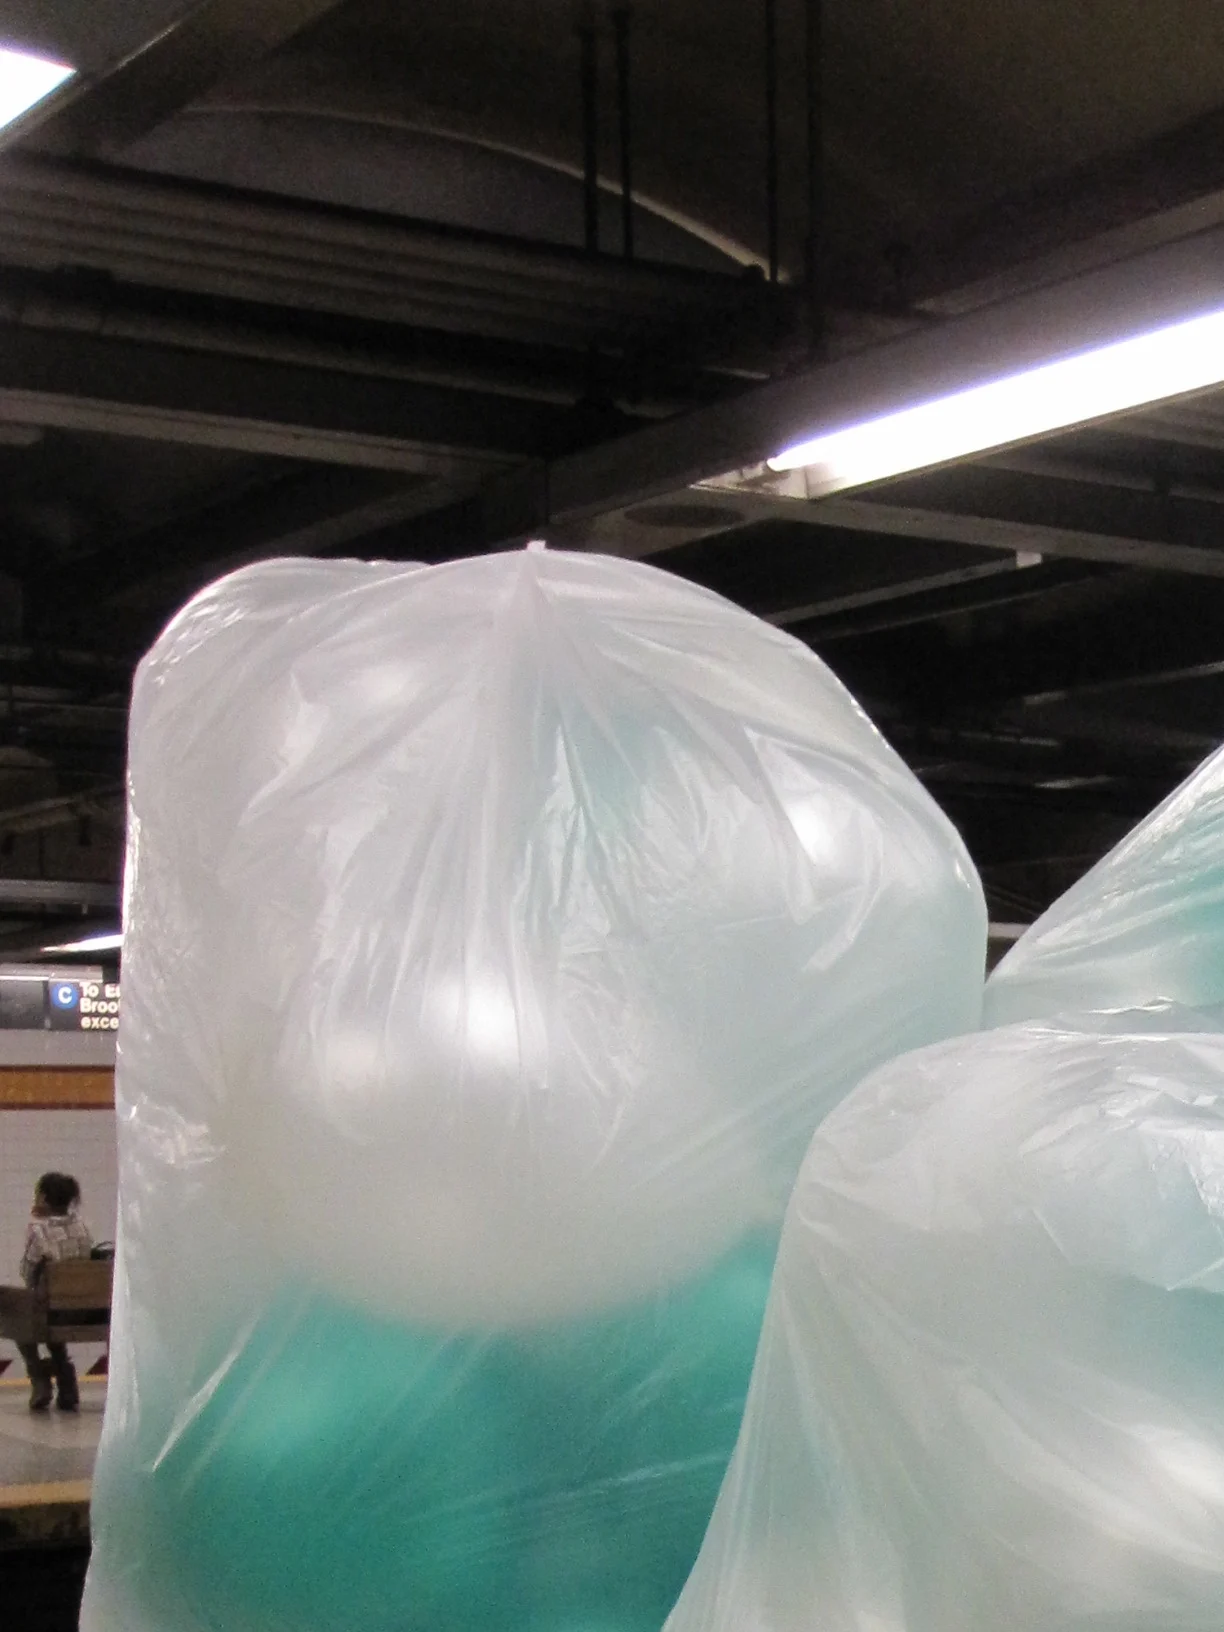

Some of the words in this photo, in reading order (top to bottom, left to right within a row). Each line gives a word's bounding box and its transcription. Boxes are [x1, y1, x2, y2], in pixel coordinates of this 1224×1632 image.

[58, 986, 73, 1004] C
[79, 982, 99, 998] To
[80, 997, 121, 1013] Broo
[80, 1016, 119, 1029] exce
